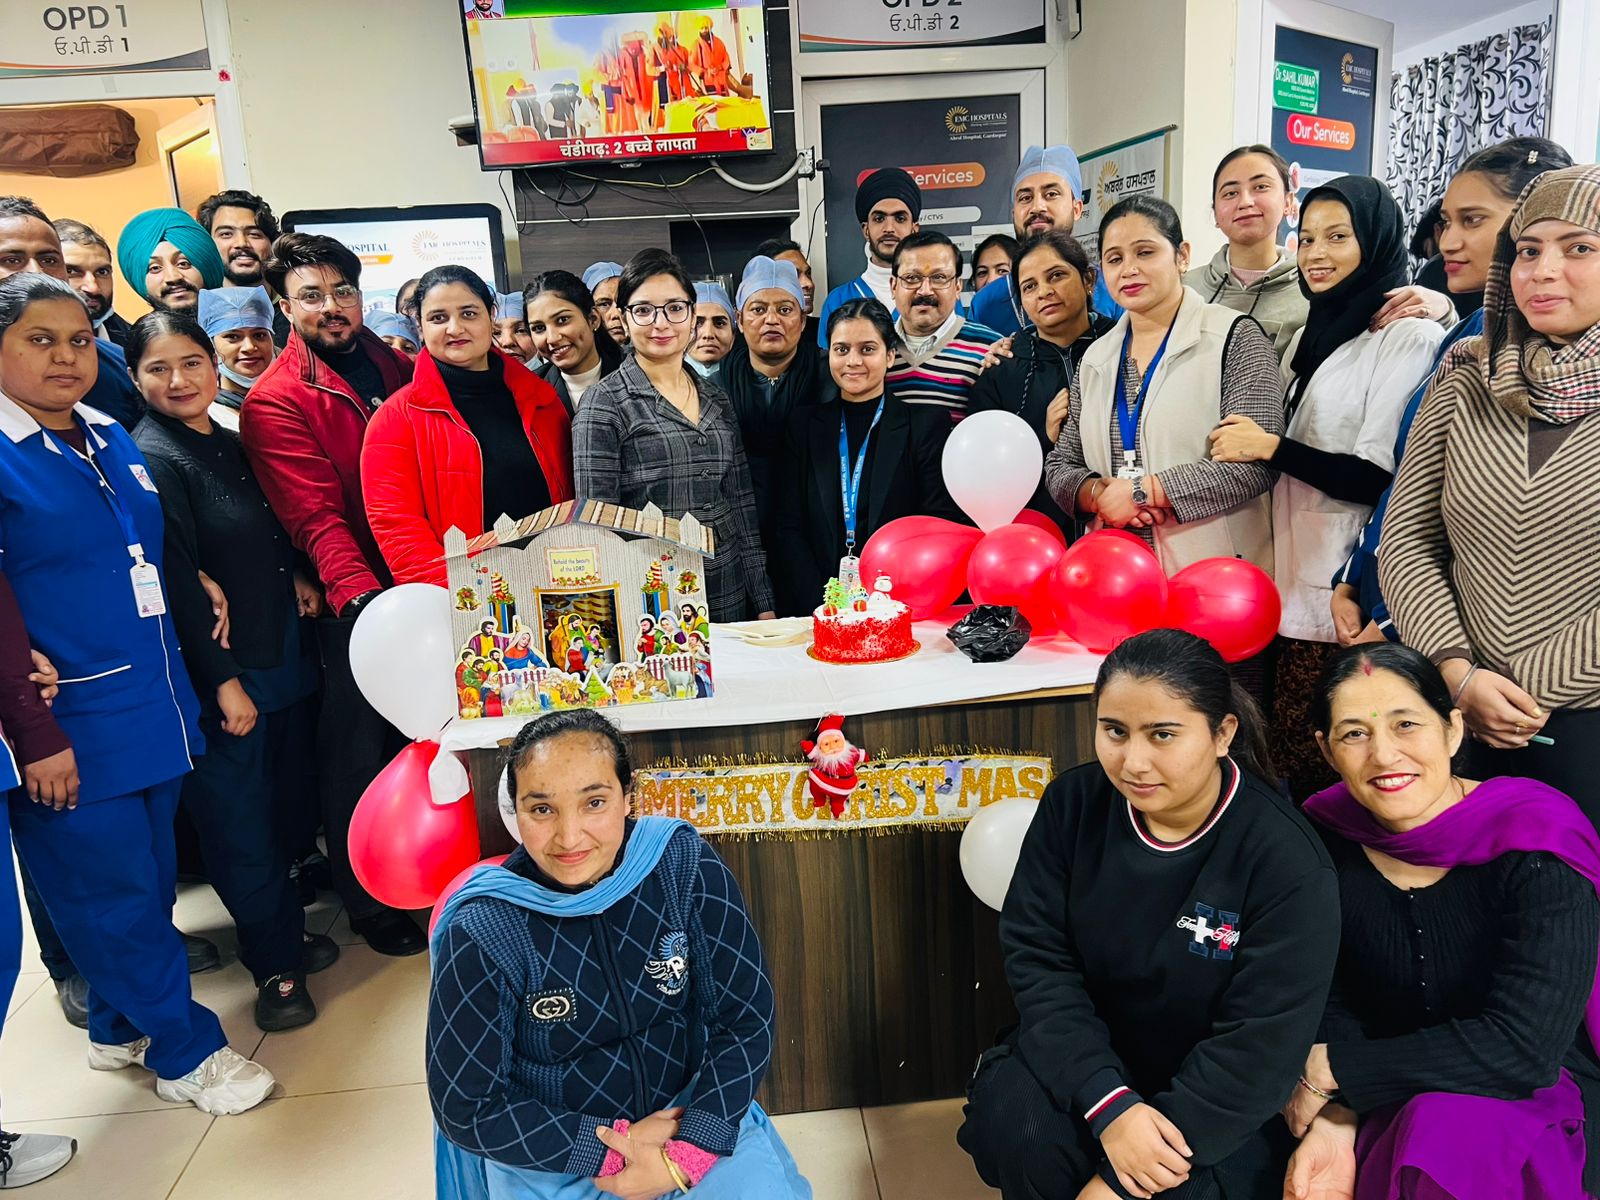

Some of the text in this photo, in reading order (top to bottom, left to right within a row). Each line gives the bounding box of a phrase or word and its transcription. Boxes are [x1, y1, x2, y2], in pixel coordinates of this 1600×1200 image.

[43, 4, 127, 31] OPD 1
[950, 15, 960, 30] 2
[121, 37, 129, 52] 1
[970, 112, 1008, 122] HOSPITALS
[1293, 119, 1350, 145] Our Services
[613, 142, 623, 155] 2
[624, 136, 653, 154] बच्चे
[655, 137, 696, 152] लापता
[927, 213, 943, 221] CTVS
[640, 767, 1045, 827] MERRY CRIST MAS
